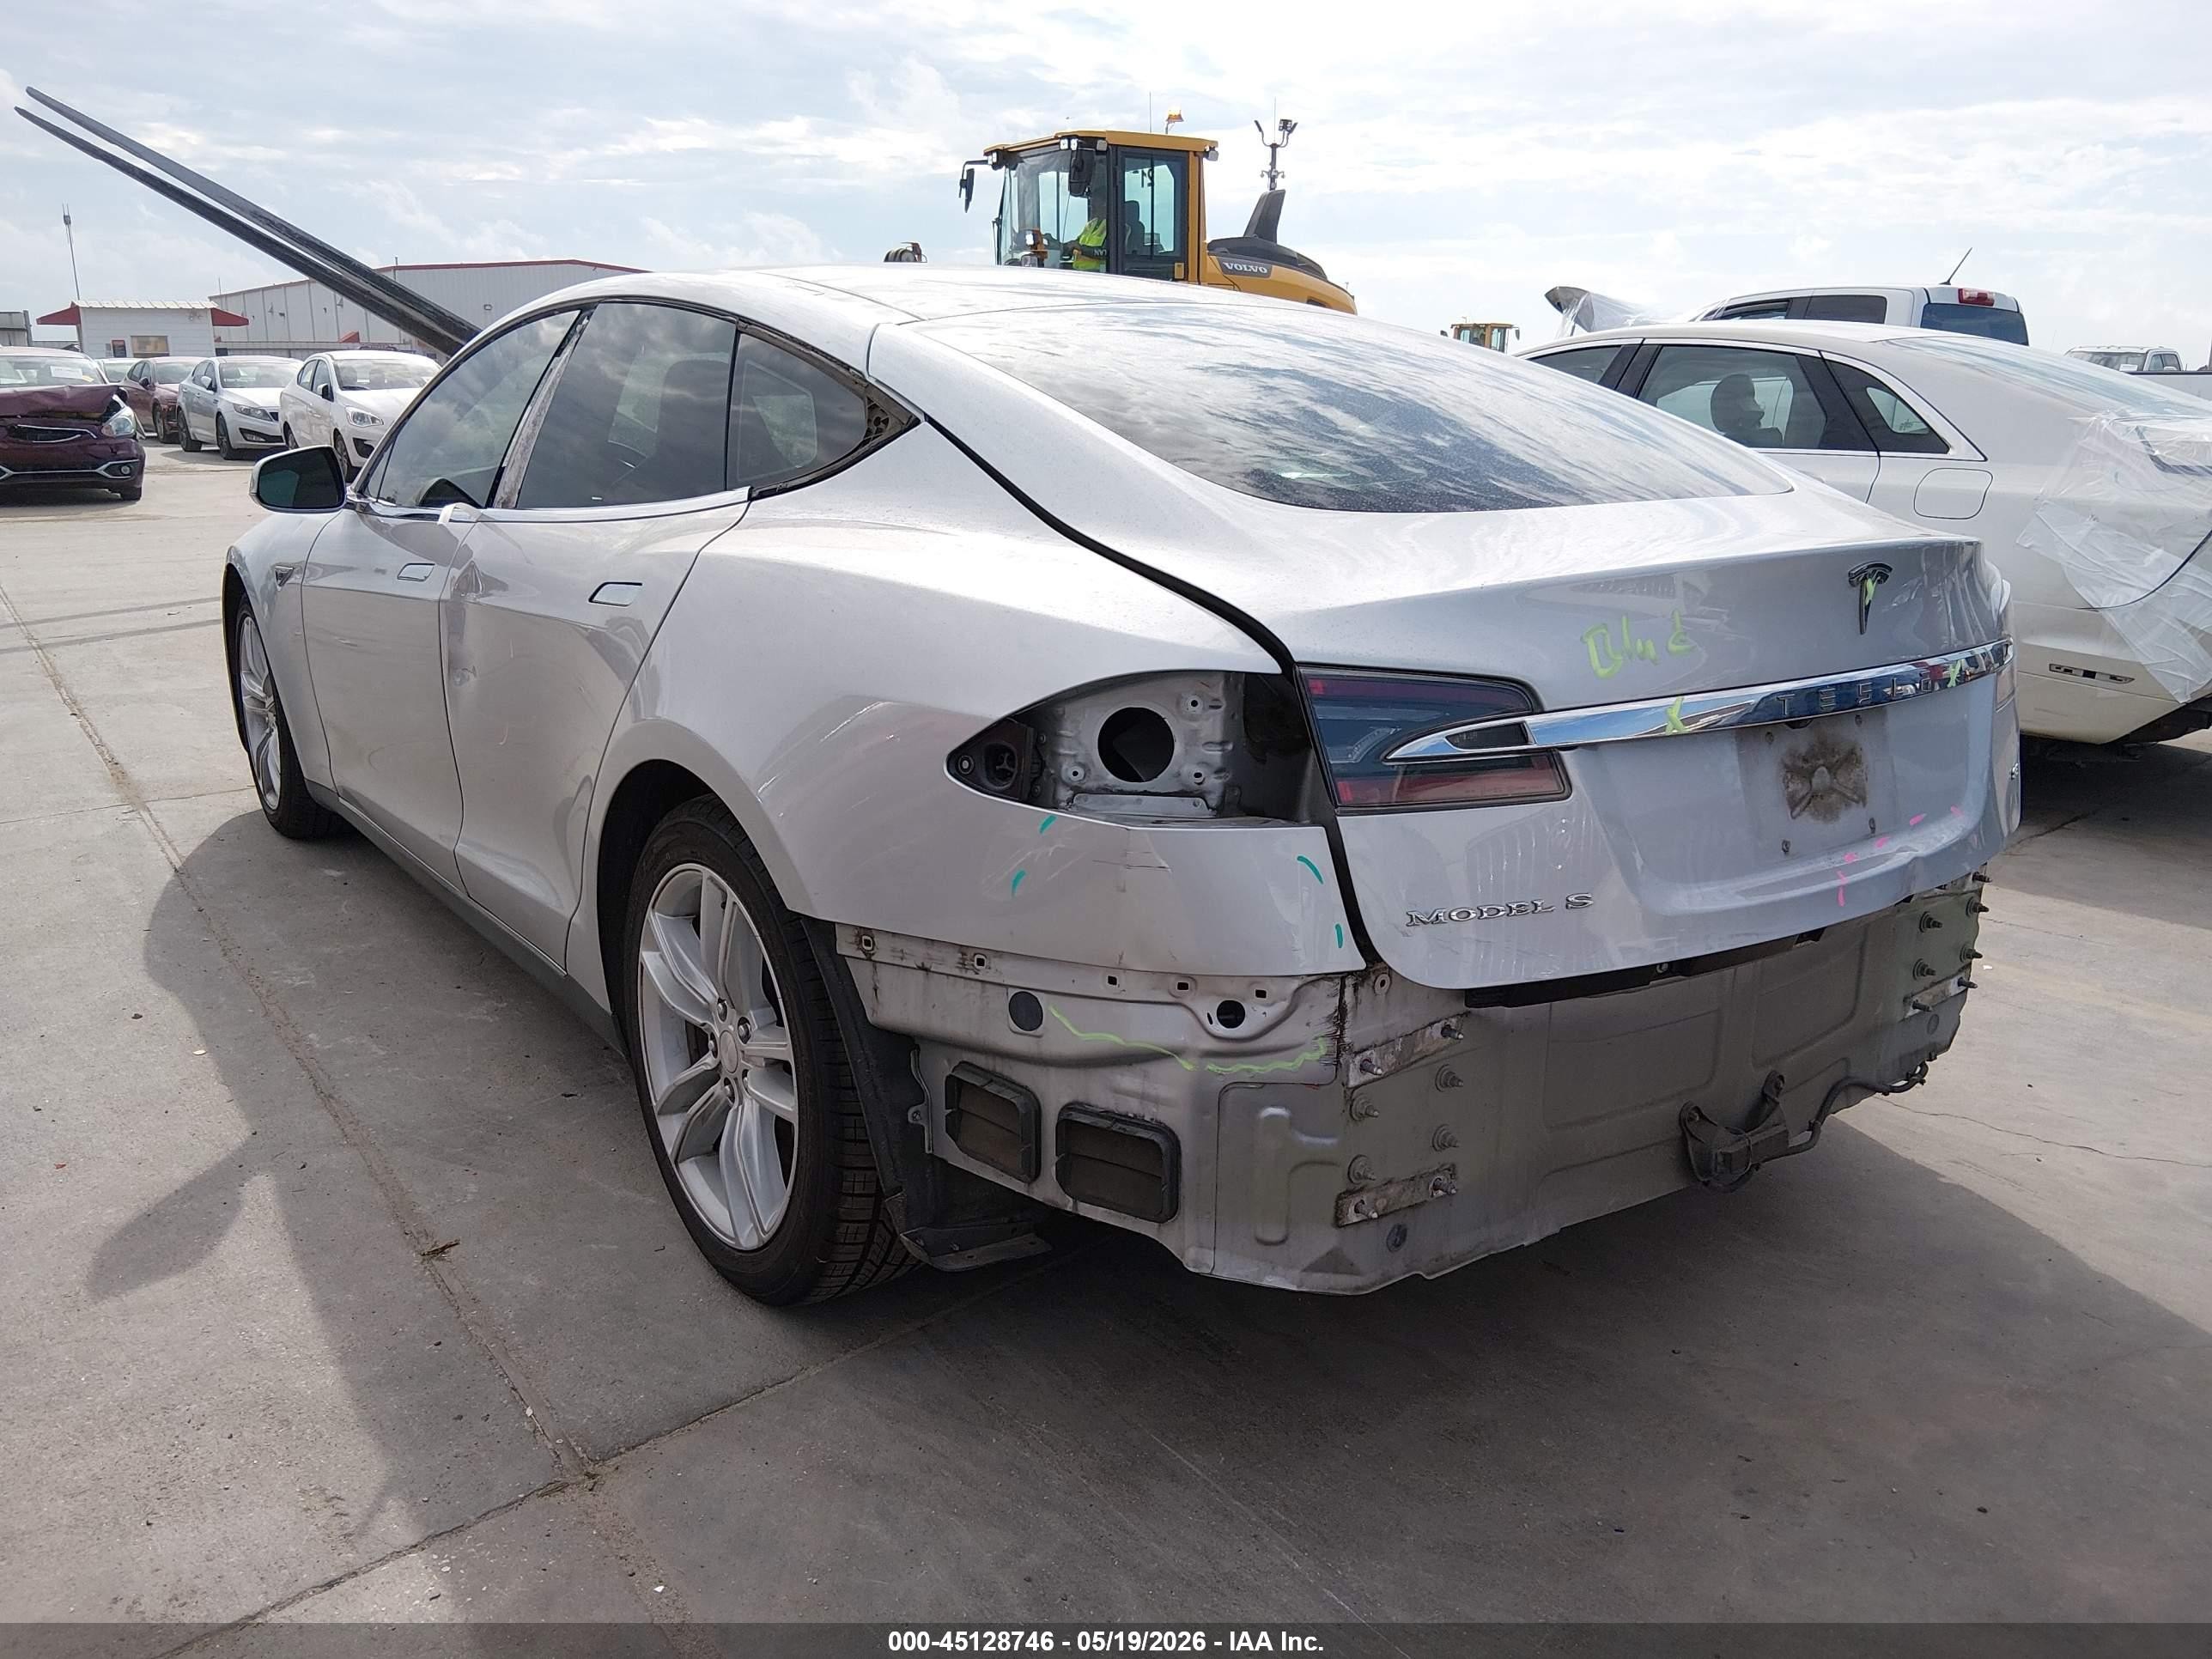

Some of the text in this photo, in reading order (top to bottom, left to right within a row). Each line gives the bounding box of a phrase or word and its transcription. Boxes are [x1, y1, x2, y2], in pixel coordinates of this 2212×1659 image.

[1222, 262, 1268, 274] VOLVO
[1406, 892, 1594, 927] MODEL S
